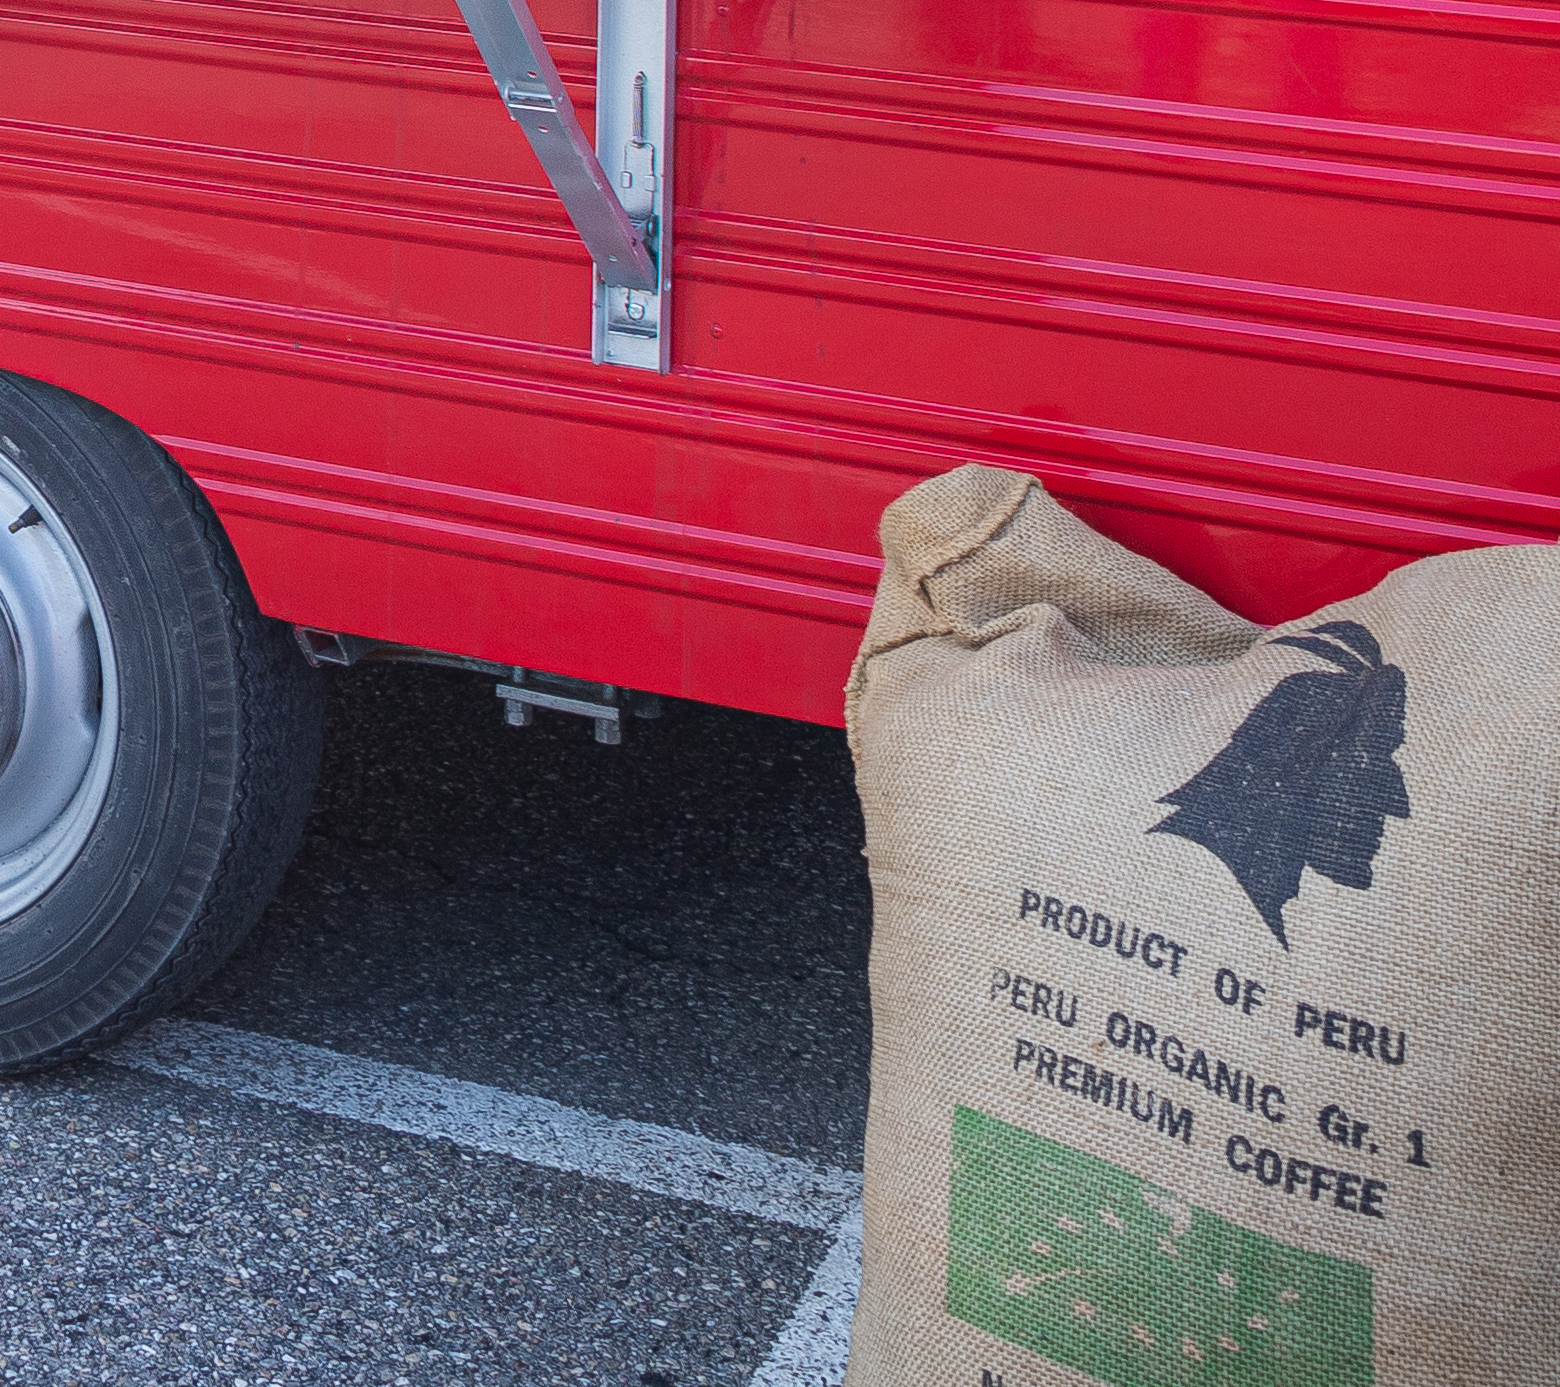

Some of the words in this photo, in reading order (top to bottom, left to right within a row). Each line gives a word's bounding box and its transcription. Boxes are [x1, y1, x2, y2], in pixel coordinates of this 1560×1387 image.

[989, 967, 1079, 1028] PERU
[1105, 1011, 1287, 1125] ORGANIC
[1318, 1104, 1380, 1155] Gr.
[1406, 1129, 1431, 1169] 1
[1019, 888, 1188, 979] PRODUCT
[1214, 968, 1266, 1016] OF
[1293, 1002, 1407, 1067] PERU
[1012, 1037, 1194, 1146] PREMIUM
[1225, 1134, 1388, 1220] COFFEE
